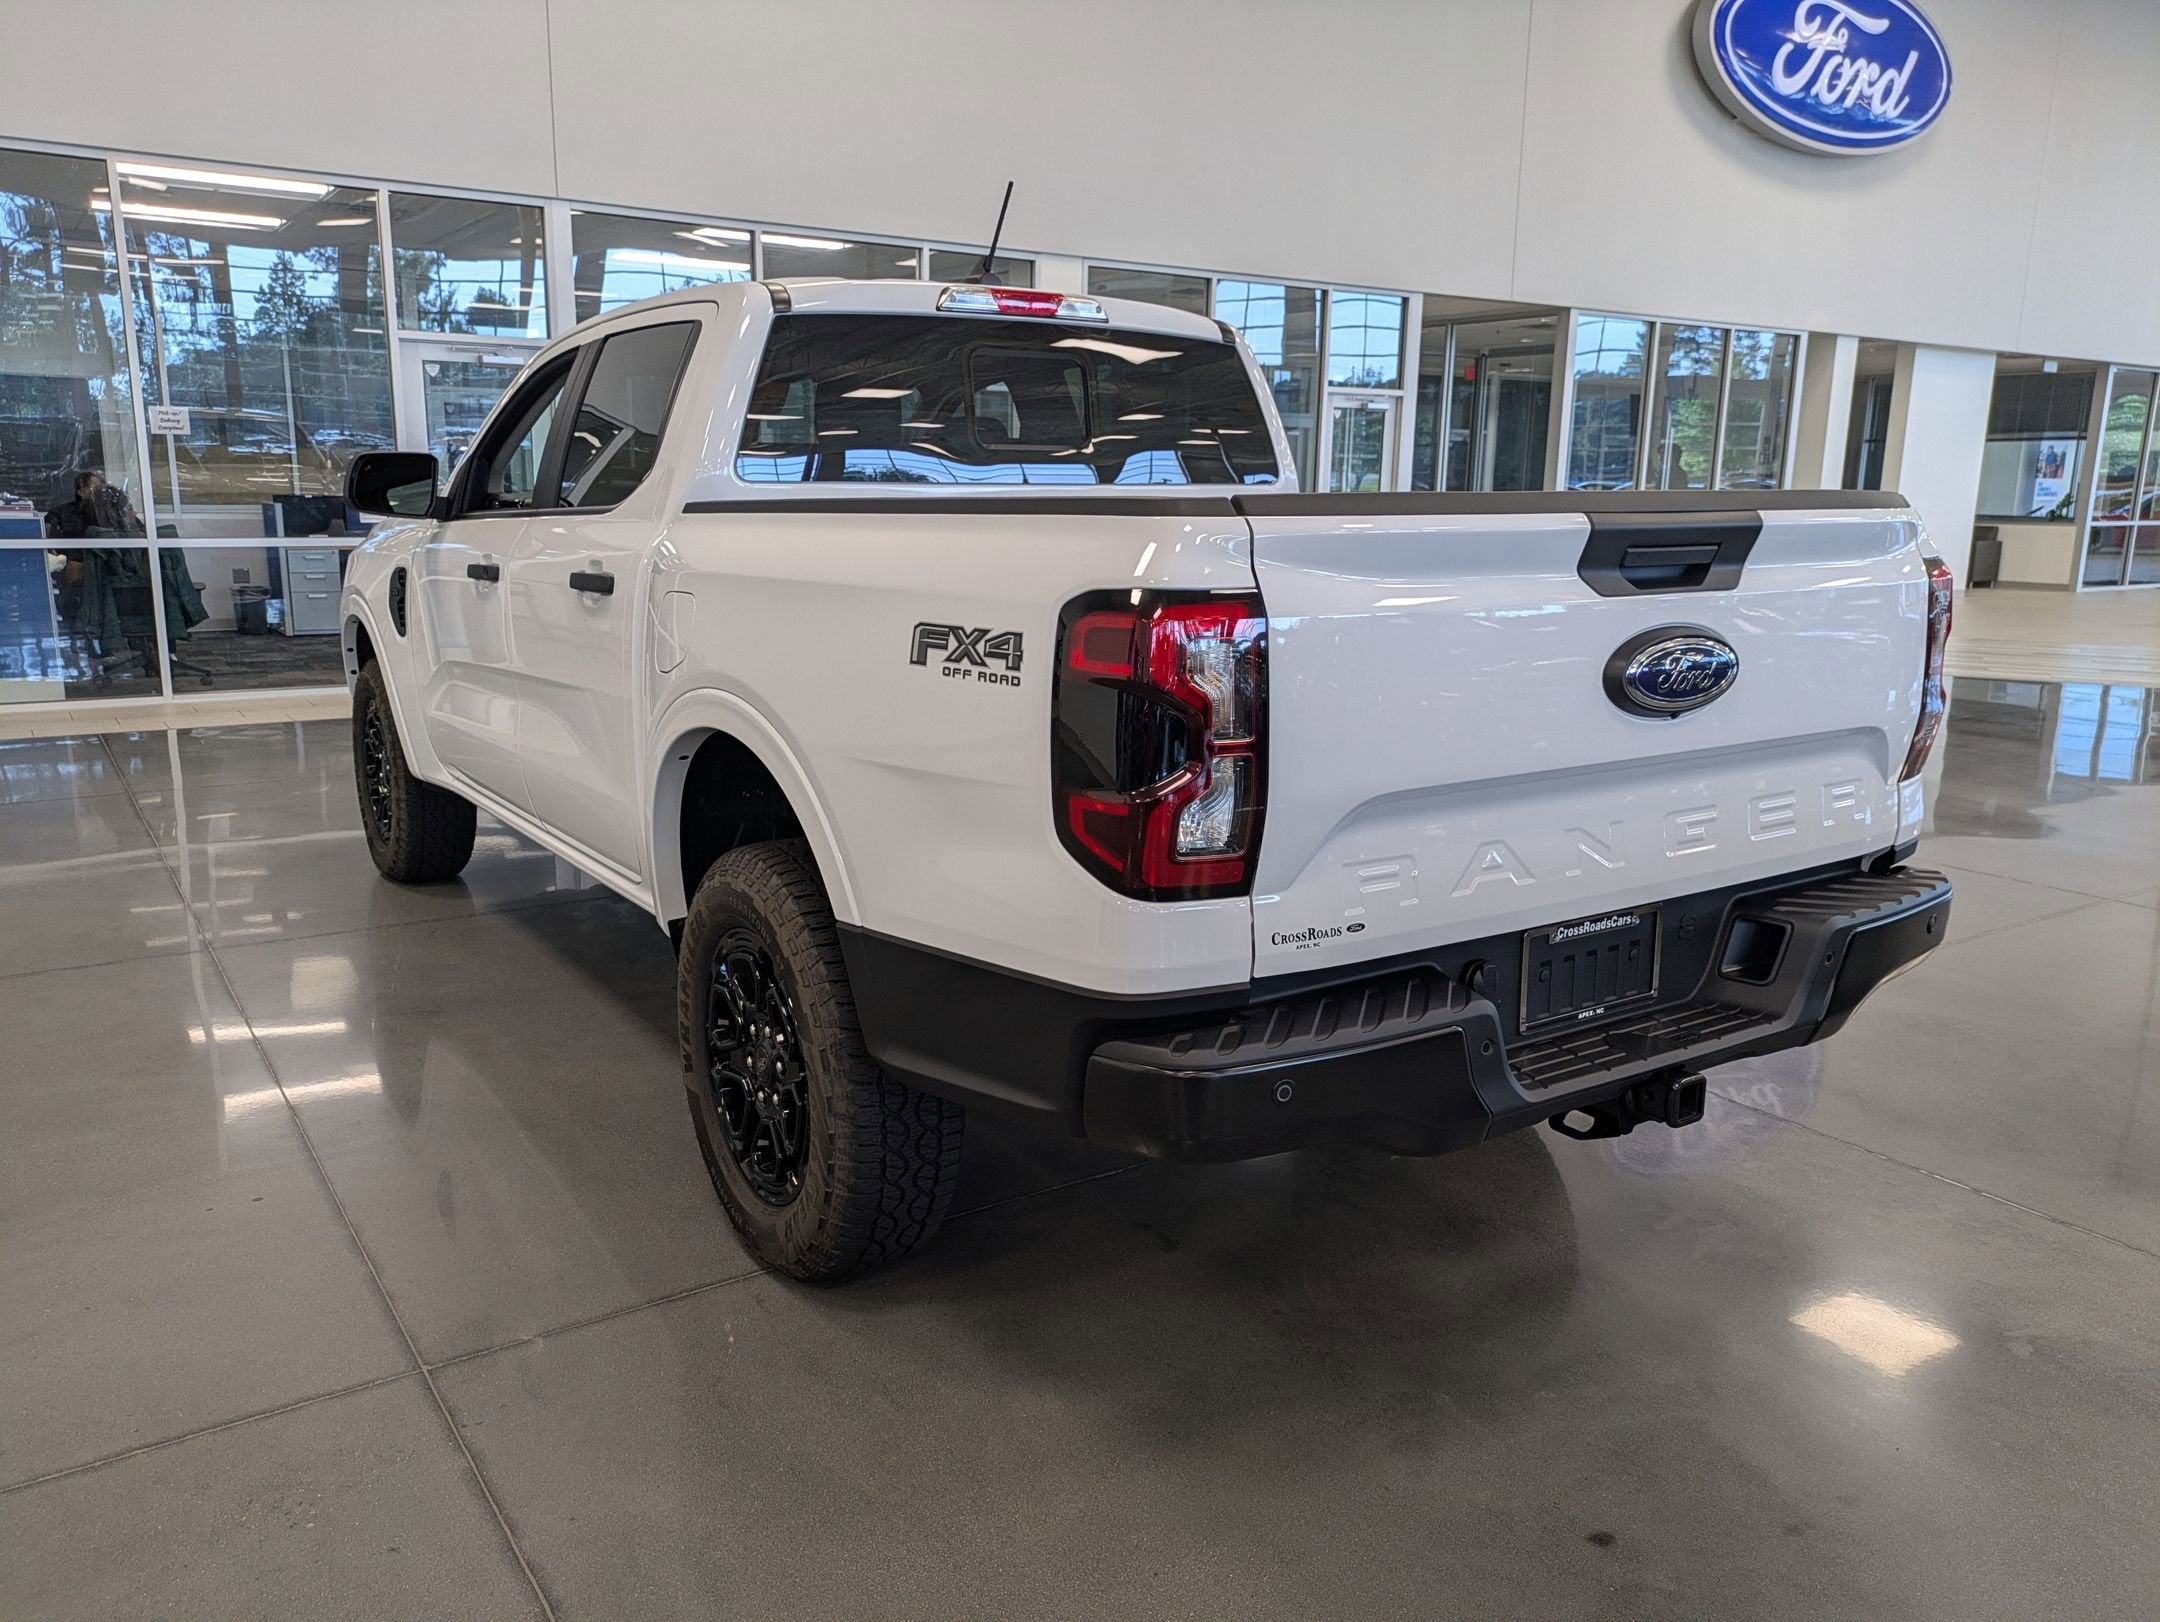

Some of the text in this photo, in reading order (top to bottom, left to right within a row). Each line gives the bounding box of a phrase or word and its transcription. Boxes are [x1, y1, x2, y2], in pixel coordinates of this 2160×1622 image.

[1772, 0, 1919, 119] Ford
[909, 621, 1024, 672] FX4
[1657, 650, 1718, 693] Ford
[942, 666, 1021, 687] OFF ROAD
[1342, 778, 1866, 916] RANGER
